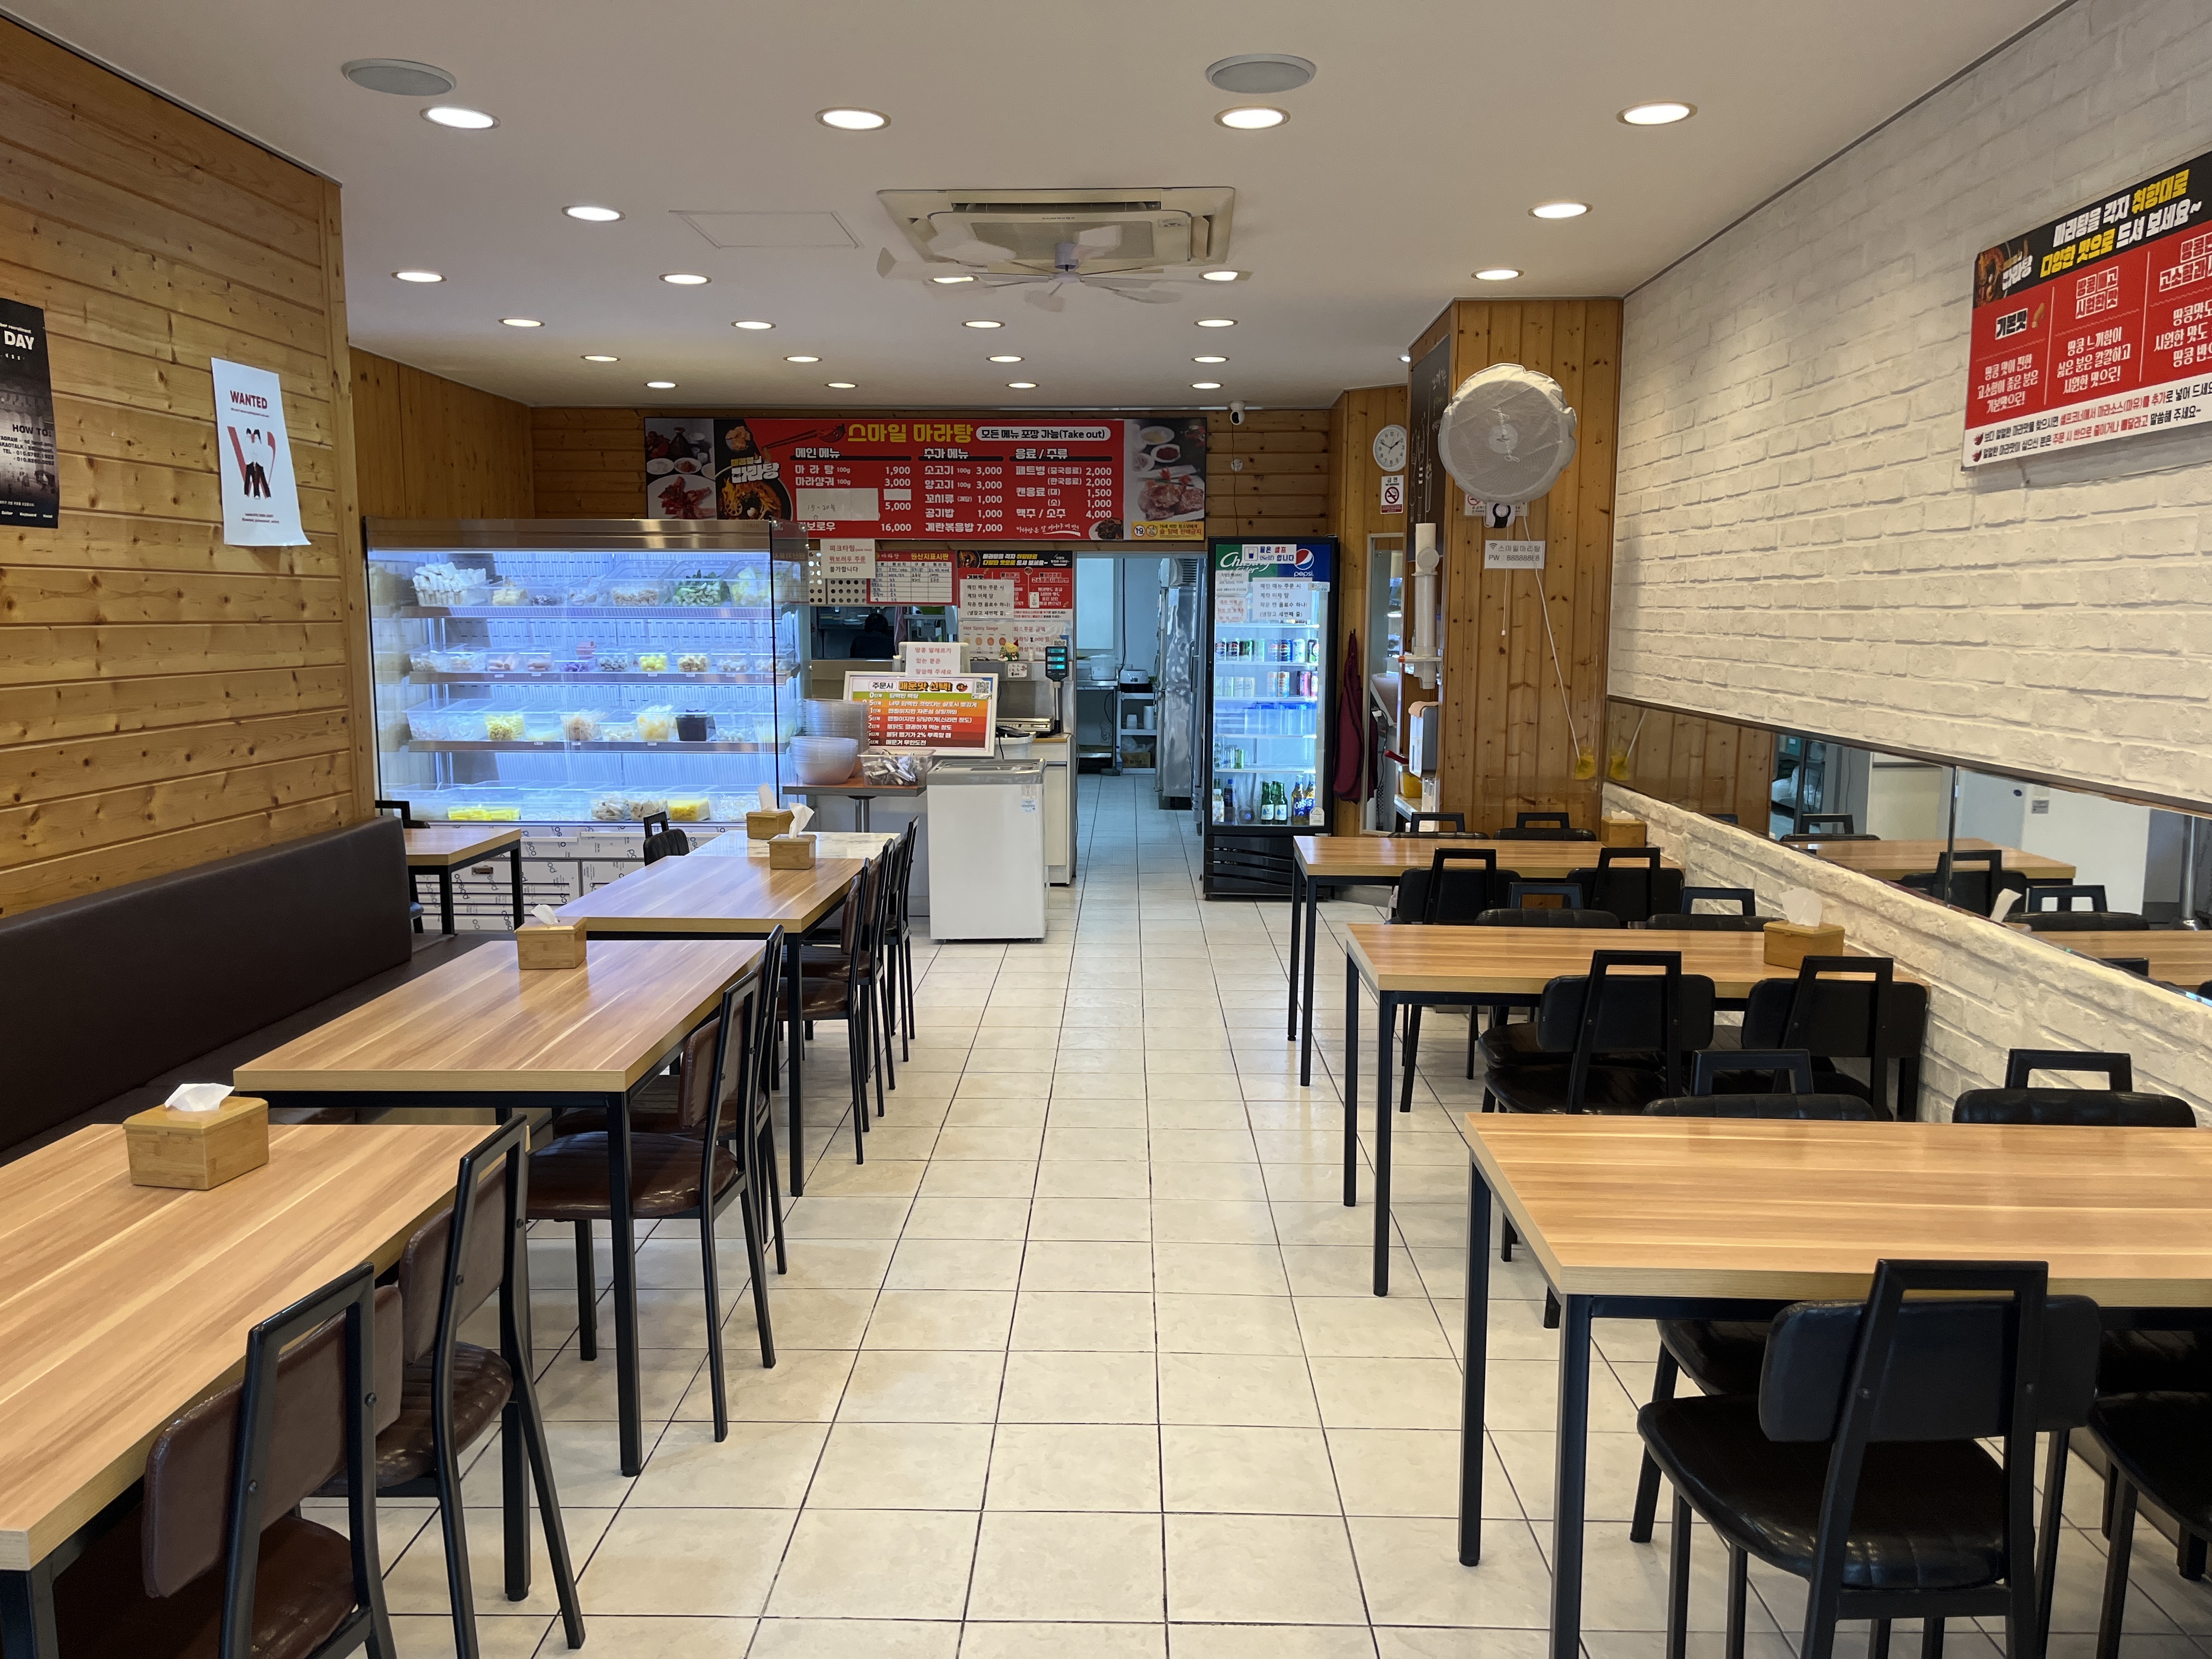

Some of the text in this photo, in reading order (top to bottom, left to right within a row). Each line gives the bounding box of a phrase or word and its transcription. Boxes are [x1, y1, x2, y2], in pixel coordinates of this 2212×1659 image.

[2053, 168, 2189, 247] 마라탕을 각자 취향대로
[2040, 245, 2076, 278] 다양한
[2077, 228, 2115, 263] 맛으로
[2116, 216, 2145, 249] 드셔
[2146, 198, 2202, 237] 보세요~
[2160, 257, 2206, 291] 고소함과
[2076, 274, 2097, 298] 땅콩
[2076, 291, 2106, 319] 시원한
[1995, 308, 2028, 340] 기본맛
[4, 330, 34, 350] DAY
[2067, 326, 2122, 357] 땅콩 느끼함이
[2153, 322, 2208, 352] 시원한 맛도
[2057, 343, 2130, 379] 싫은 분은 칼칼하고
[2173, 347, 2194, 368] 땅콩
[1985, 358, 2016, 381] 땅콩 맛이
[1977, 370, 2039, 400] 고소함이 좋은 분은
[2063, 365, 2121, 394] 시원한 맛으로!
[230, 390, 268, 409] WANTED
[1987, 391, 2025, 414] 기본맛으로!
[2152, 386, 2191, 407] 추가로 넣어
[13, 424, 52, 437] HOW TO:
[2040, 405, 2202, 448] 분은 주문 시 반으로 줄이거나 말씀해 주세요~
[848, 424, 973, 443] 스마일 마라탕
[981, 430, 1105, 439] 모든 메뉴 포장 out)
[795, 448, 840, 458] 메인 메뉴
[924, 448, 969, 459] 추가 메뉴
[1015, 448, 1068, 459] 음료 주류
[885, 466, 911, 476] 1,900
[924, 465, 953, 475] 소고기
[976, 466, 1002, 476] 3,000
[1015, 466, 1045, 476] 페트병
[1086, 467, 1112, 476] 2,000
[795, 477, 834, 487] 마라샹궈
[884, 478, 911, 488] 3,000
[924, 479, 953, 489] 양고기
[976, 481, 1002, 490] 3,000
[1086, 478, 1112, 487] 2,000
[1016, 487, 1046, 497] 캔음료
[1087, 489, 1112, 498] 1,500
[925, 494, 954, 504] 꼬치류
[978, 495, 1003, 505] 1,000
[1087, 499, 1112, 509] 1,000
[885, 503, 911, 512] 5,000
[925, 508, 1003, 519] 공기밥 1,000
[1017, 509, 1112, 519] 맥주 소주 4,000
[881, 523, 912, 533] 16,000
[925, 522, 1003, 533] 계란볶음밥 7,000
[899, 681, 928, 691] 매운맛
[929, 681, 953, 692] 선택!
